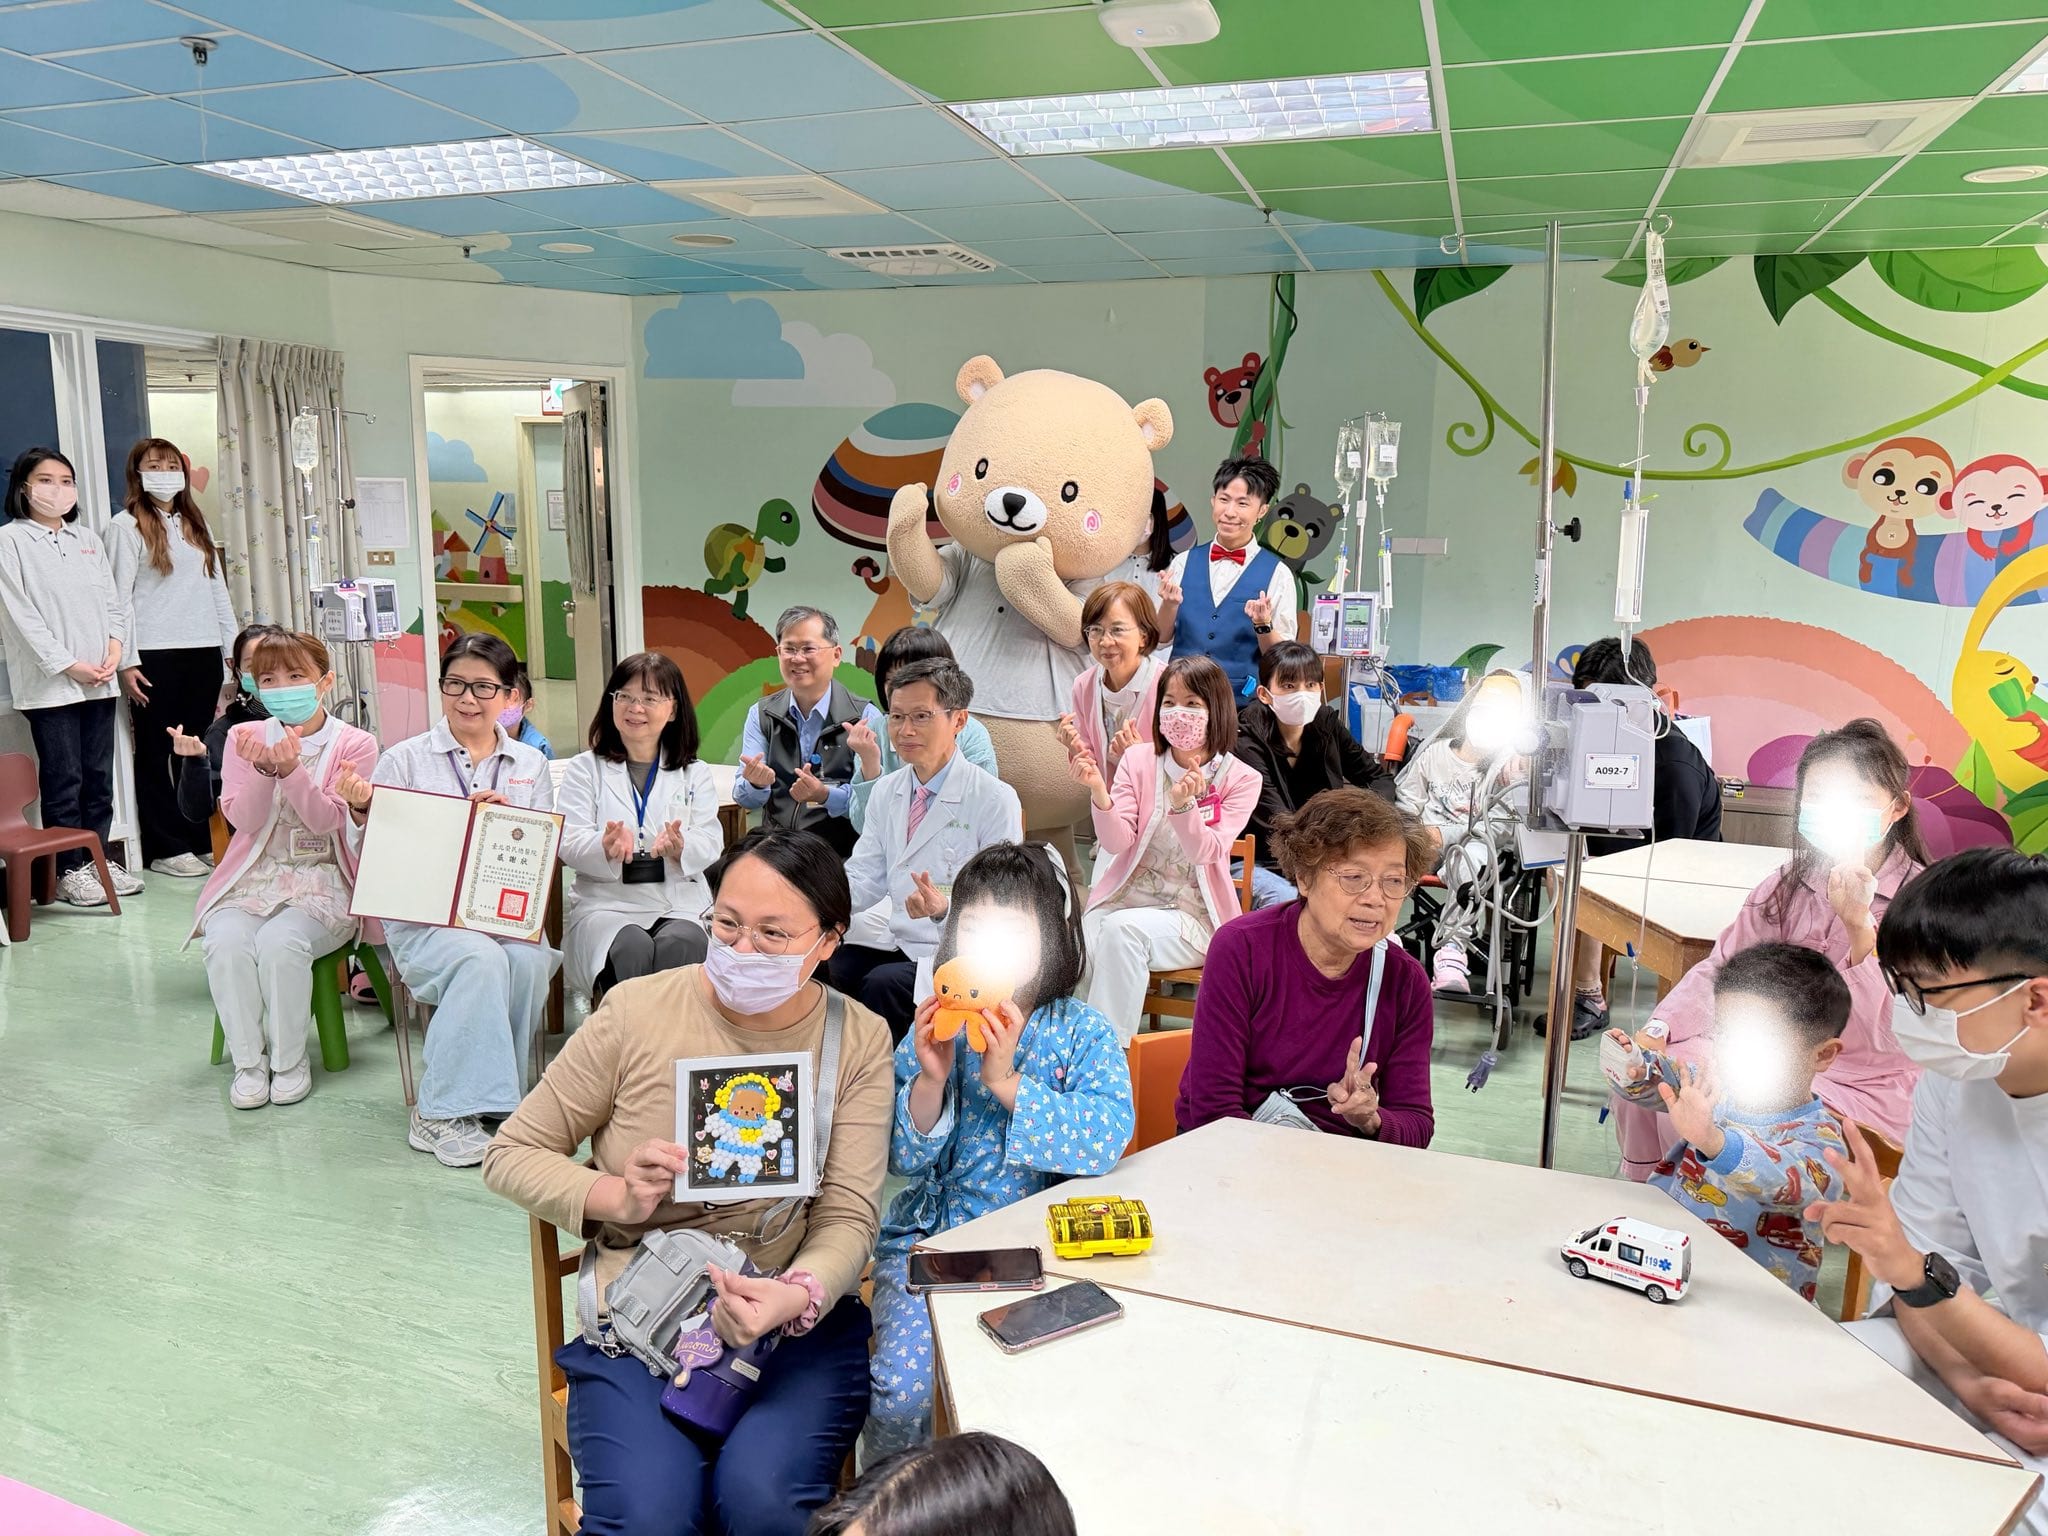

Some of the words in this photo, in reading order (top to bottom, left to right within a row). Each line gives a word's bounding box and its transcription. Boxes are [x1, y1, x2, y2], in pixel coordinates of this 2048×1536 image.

[1595, 767, 1629, 775] A092-7
[497, 853, 528, 865] 感謝狀
[1645, 1256, 1658, 1267] 119
